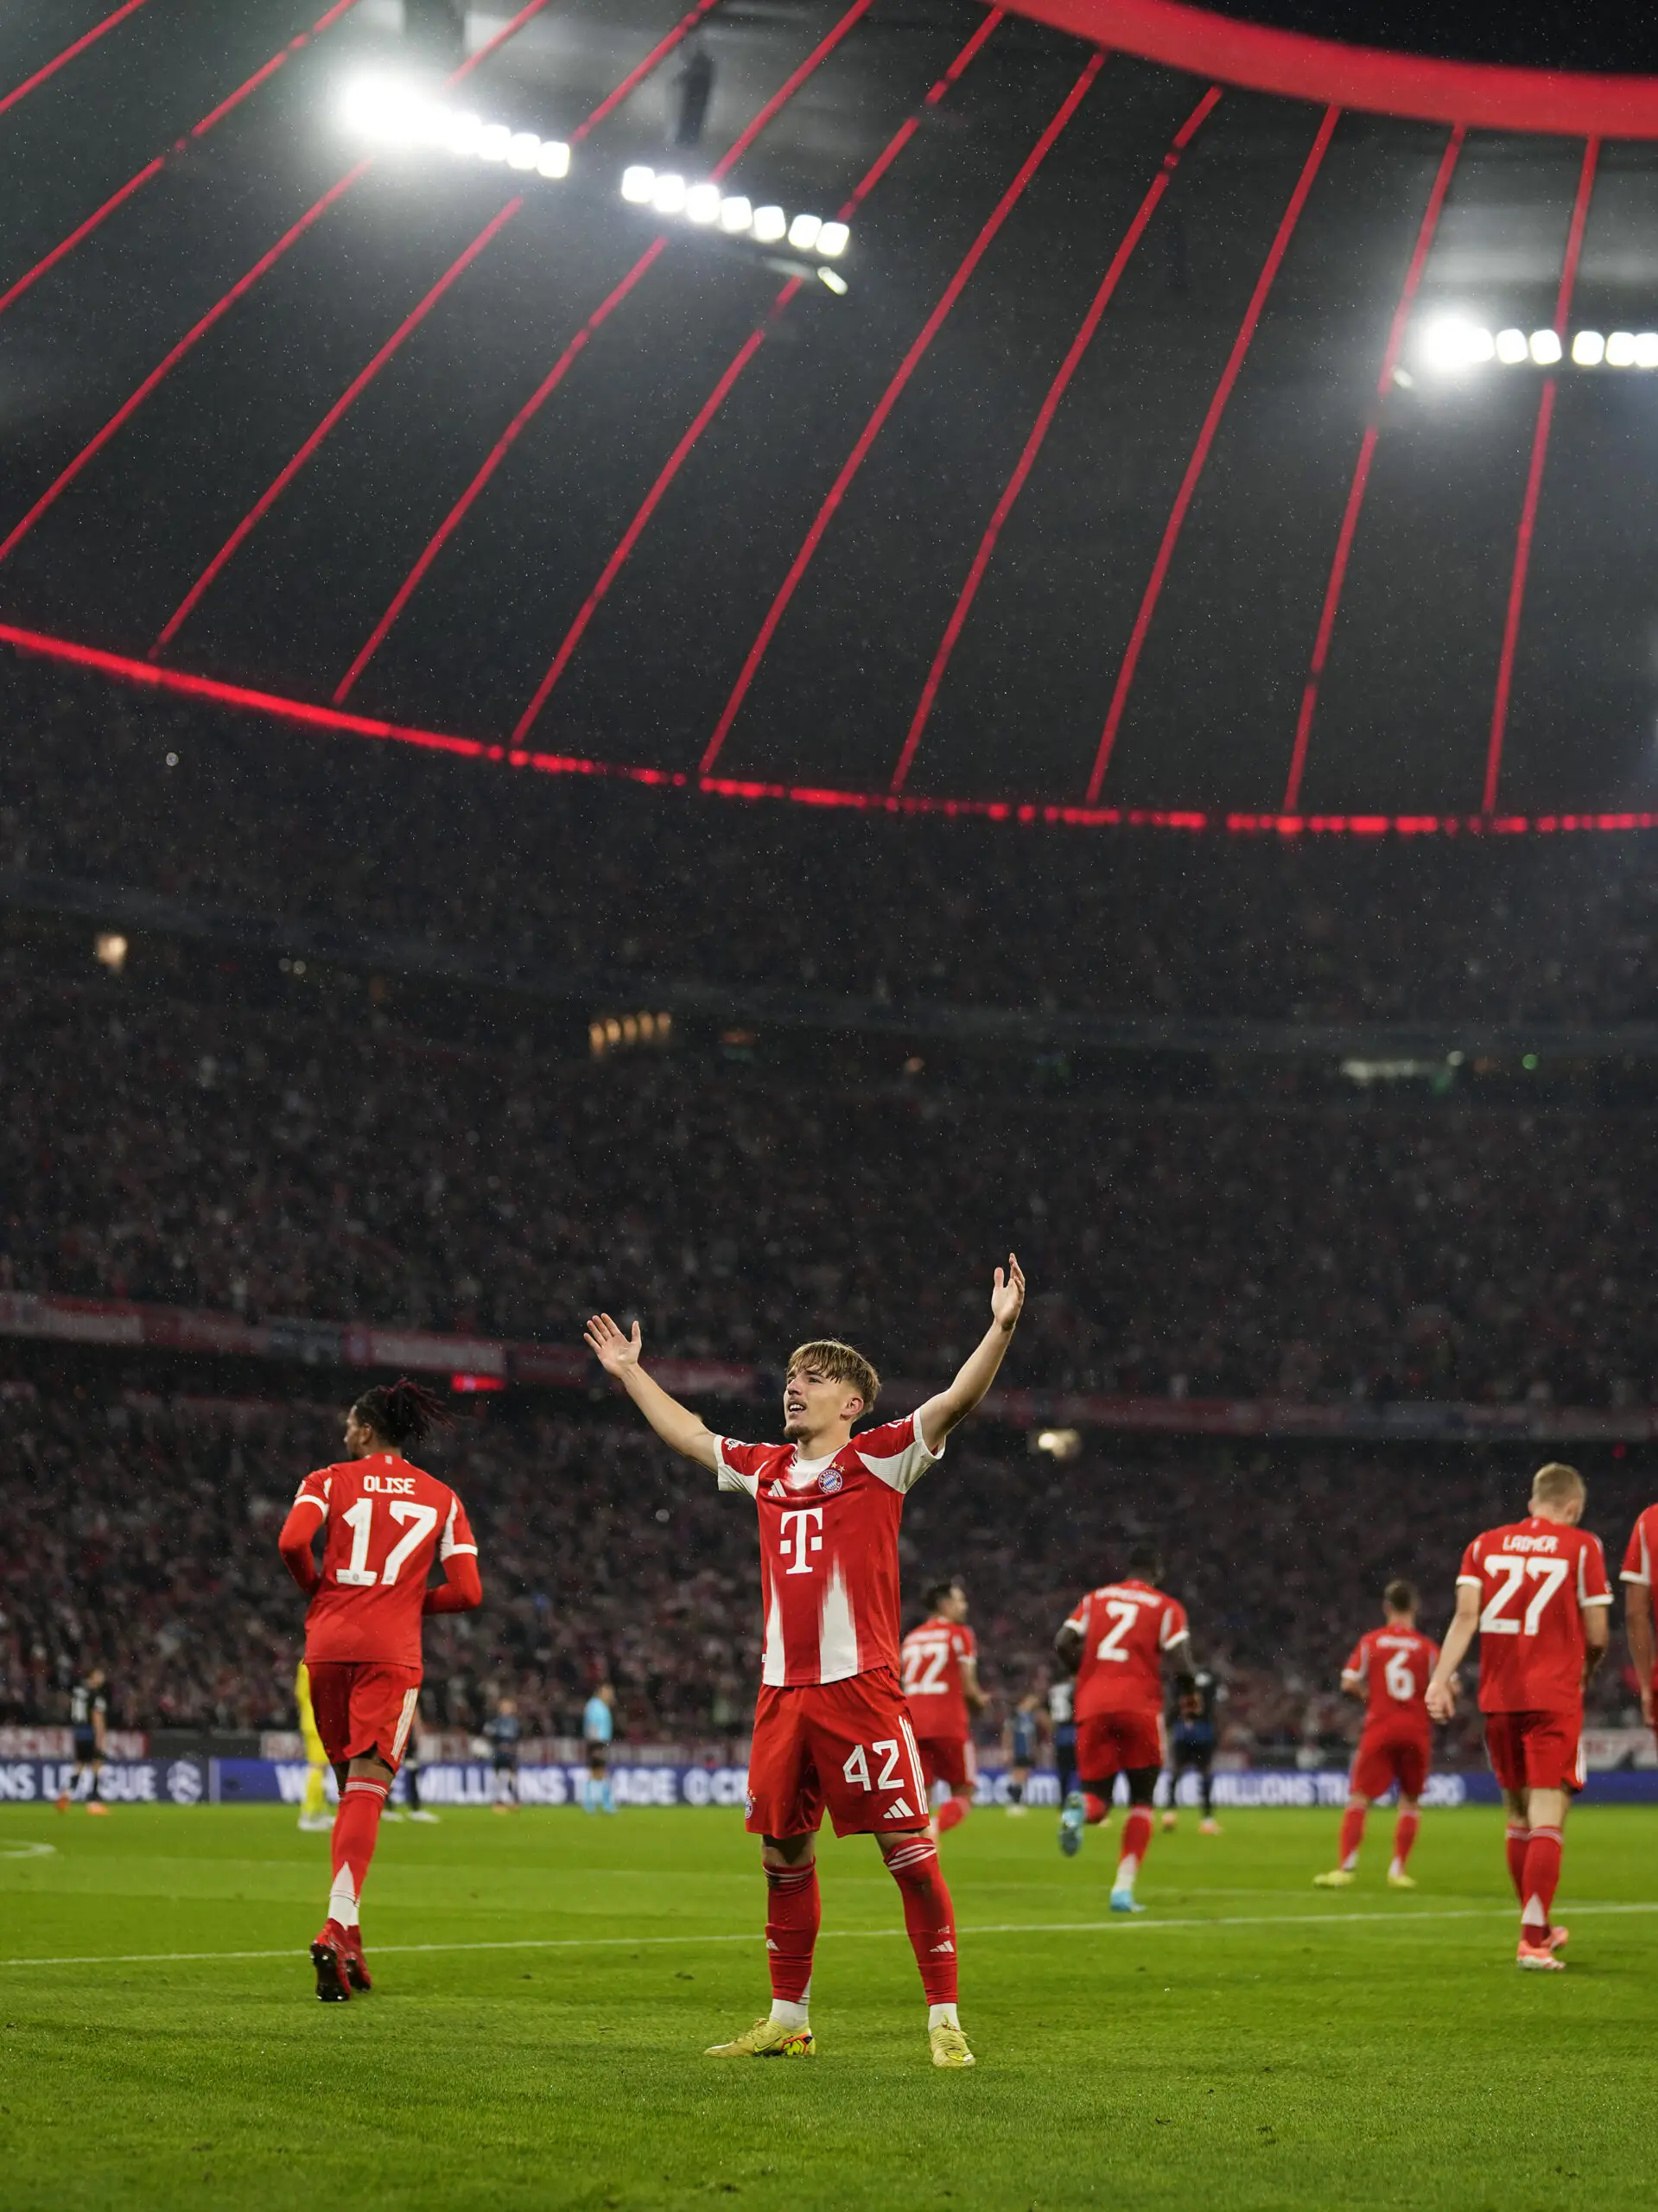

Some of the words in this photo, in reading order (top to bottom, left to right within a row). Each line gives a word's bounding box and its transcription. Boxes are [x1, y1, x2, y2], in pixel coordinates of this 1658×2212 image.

[363, 1475, 416, 1495] OLISE
[336, 1497, 438, 1586] 17
[780, 1507, 823, 1574] T
[1502, 1535, 1559, 1554] LAIMER
[1479, 1554, 1569, 1636] 27
[1096, 1600, 1140, 1662] 2
[901, 1642, 949, 1694] 22
[1385, 1649, 1415, 1700] 6
[568, 1766, 677, 1805] TADE
[842, 1738, 905, 1791] 42
